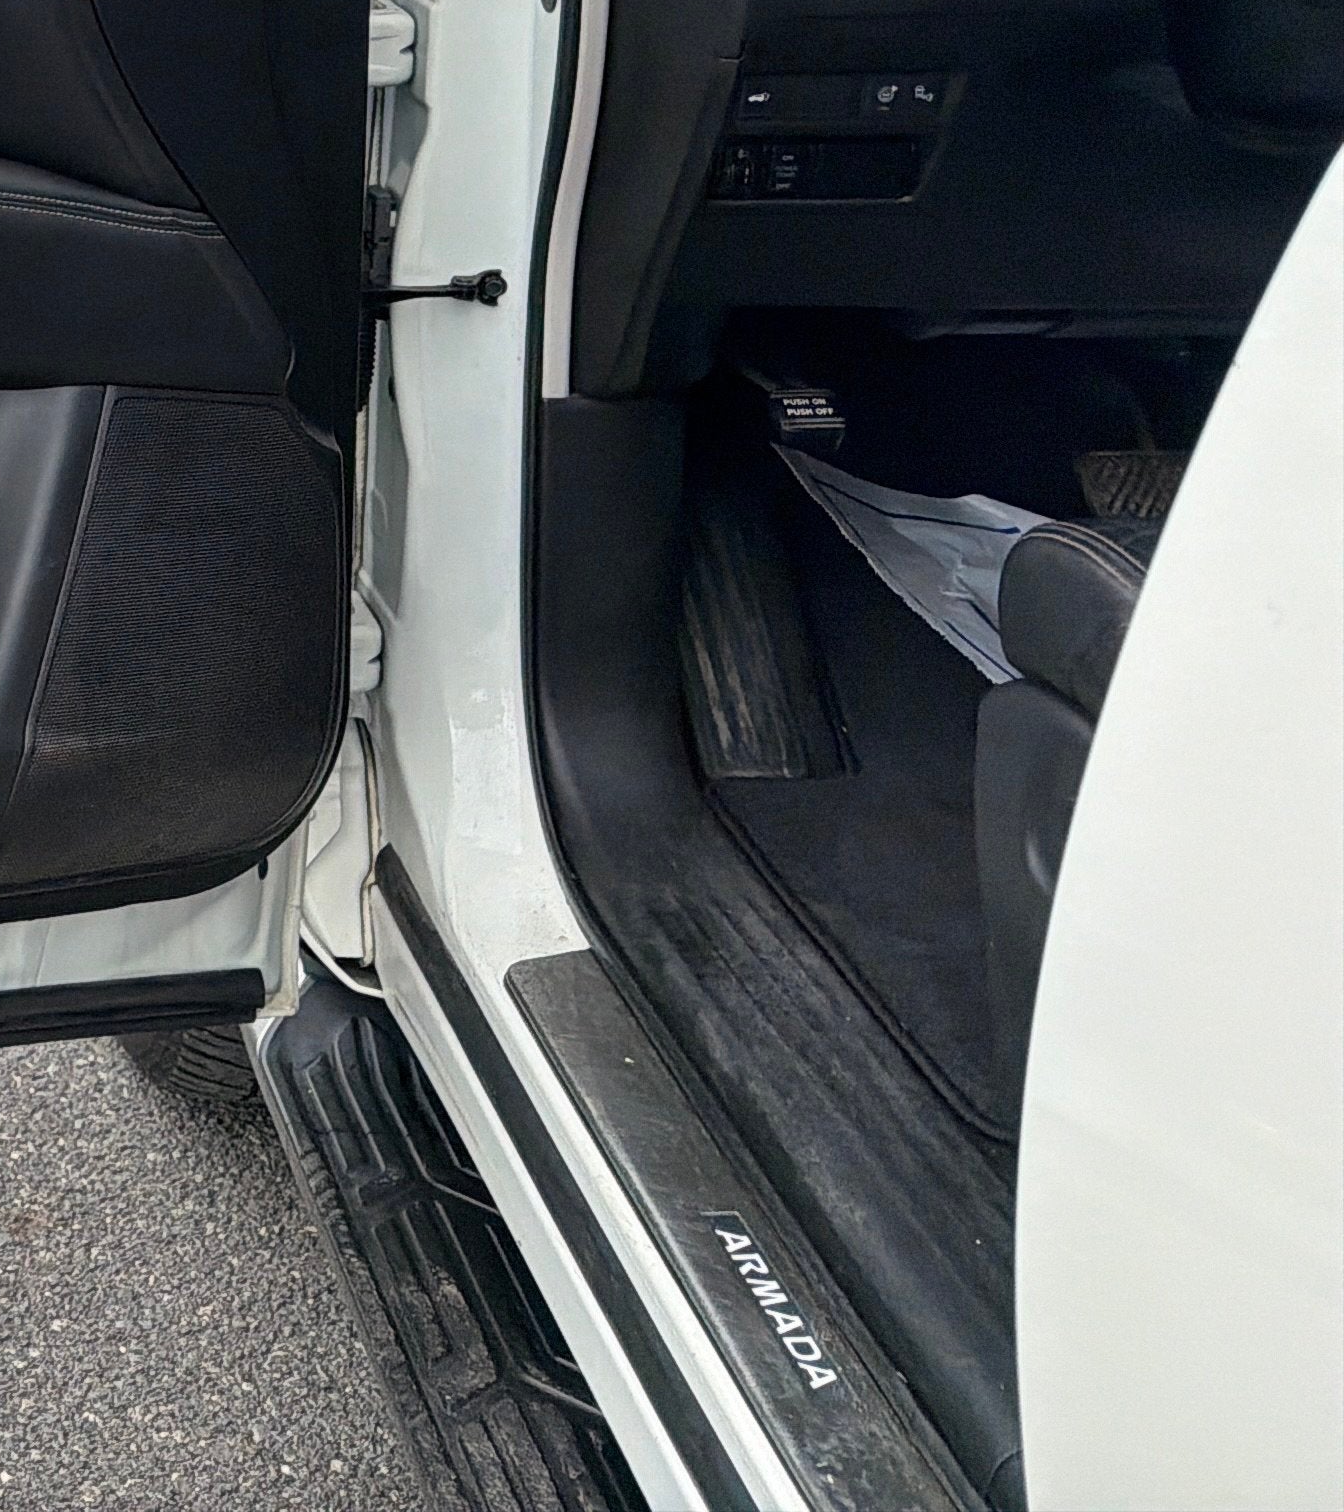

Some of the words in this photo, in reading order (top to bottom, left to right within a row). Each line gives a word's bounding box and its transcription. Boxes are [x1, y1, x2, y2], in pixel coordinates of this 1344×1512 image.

[783, 398, 810, 406] PUSH
[786, 408, 813, 416] PUSH
[815, 407, 834, 415] OFF
[714, 1228, 838, 1390] ARMADA
